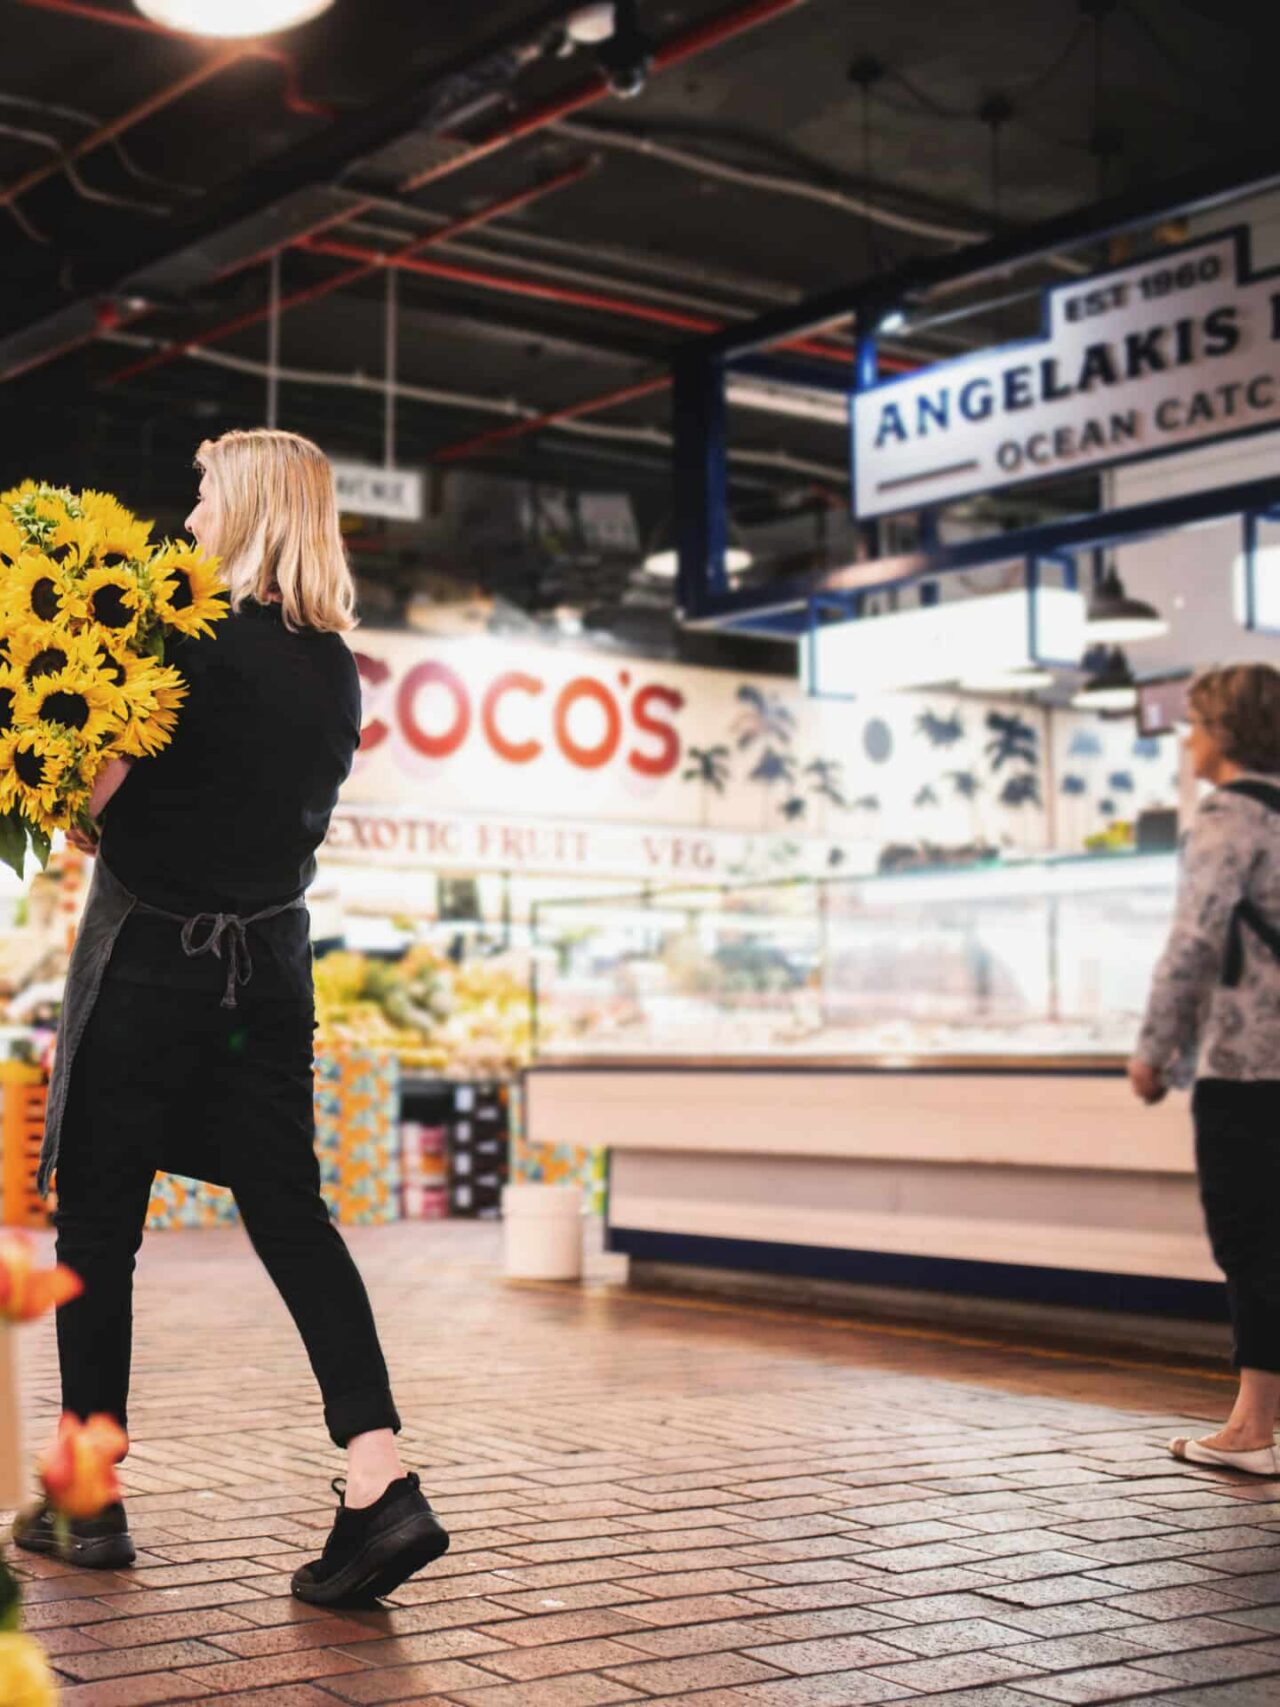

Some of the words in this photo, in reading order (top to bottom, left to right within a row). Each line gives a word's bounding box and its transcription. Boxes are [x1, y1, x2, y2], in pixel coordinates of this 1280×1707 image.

[1064, 283, 1127, 323] EST
[1139, 255, 1223, 299] 1960
[874, 306, 1240, 448] ANGELAKIS
[996, 408, 1137, 472] OCEAN
[476, 823, 591, 863] FRUIT
[640, 834, 716, 871] VEG
